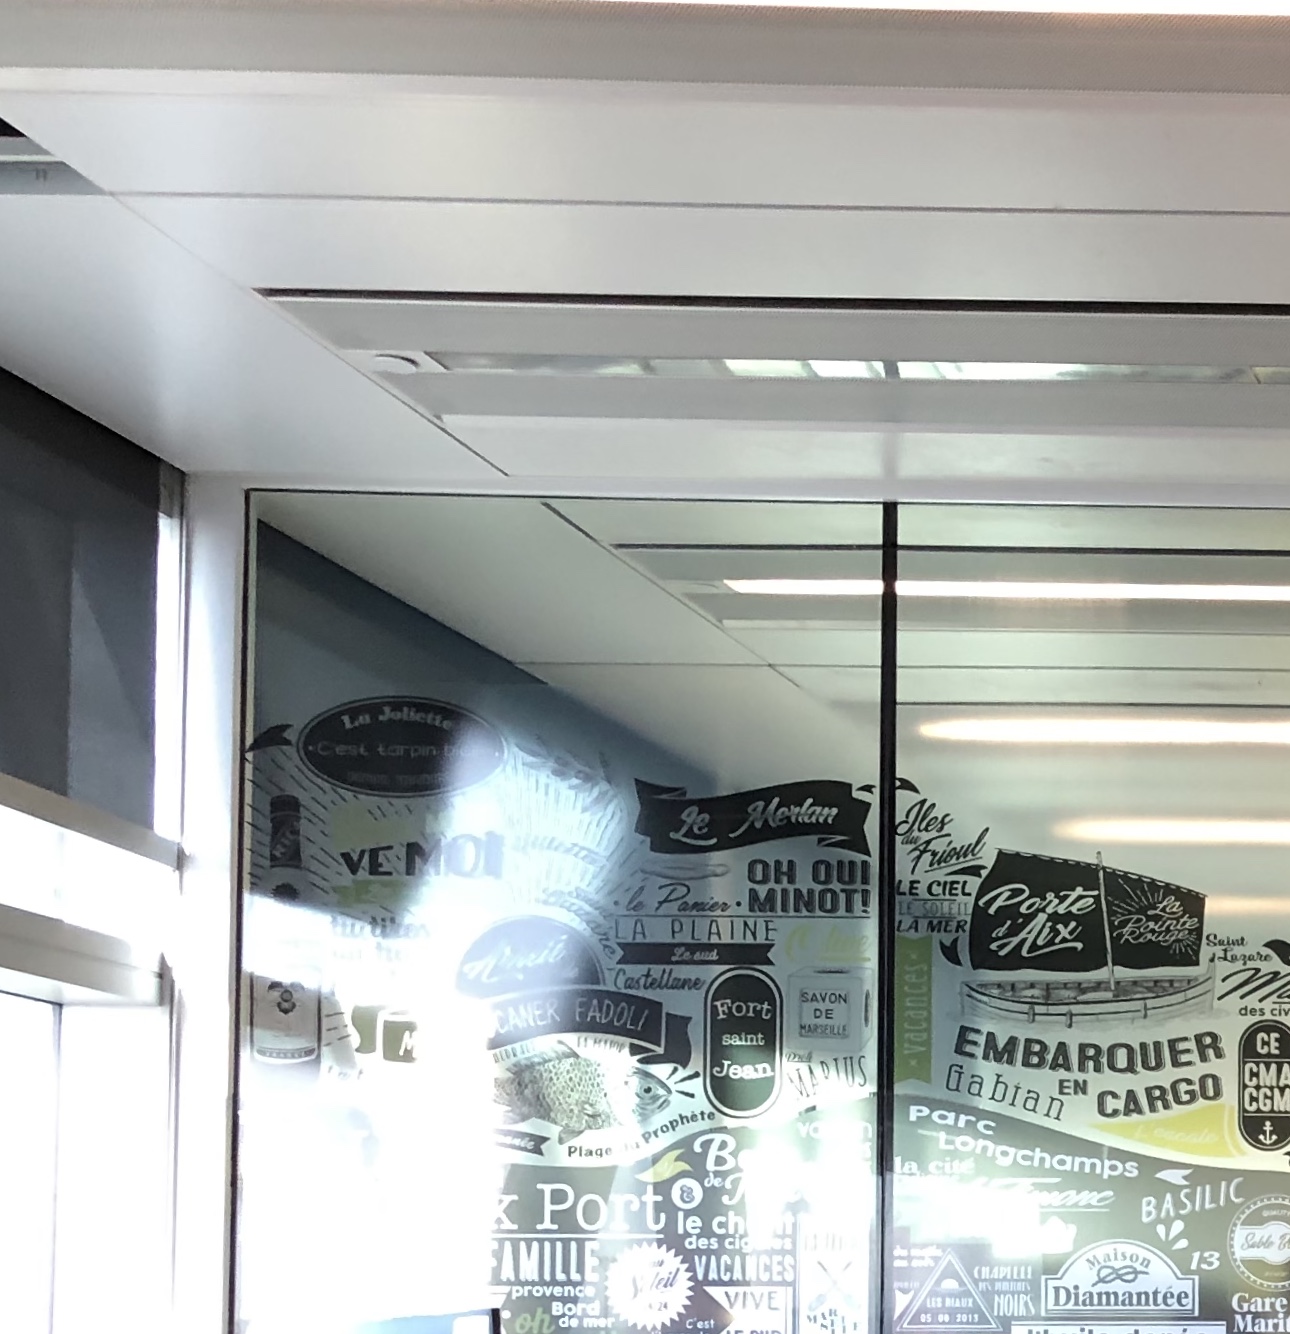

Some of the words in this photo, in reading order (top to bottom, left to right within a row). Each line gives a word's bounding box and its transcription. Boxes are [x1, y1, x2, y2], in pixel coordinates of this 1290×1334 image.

[670, 806, 718, 846] Le
[728, 797, 838, 838] Merlan
[748, 859, 796, 886] OH
[812, 859, 871, 886] OUI
[896, 880, 920, 896] LE
[927, 880, 972, 897] CIEL
[978, 883, 1100, 916] Porte
[748, 888, 872, 914] MINOT!
[614, 919, 647, 941] LA
[671, 919, 778, 942] PLAINE
[713, 999, 772, 1019] Fort
[801, 991, 848, 1005] SAVON
[813, 1008, 834, 1020] DE
[1239, 1005, 1268, 1017] des
[722, 1032, 765, 1046] saint
[953, 1025, 1227, 1074] EMBARQUER
[1256, 1032, 1280, 1055] CE
[712, 1060, 774, 1079] Jean
[945, 1063, 1066, 1121] Gabian
[1058, 1079, 1088, 1096] EN
[1097, 1073, 1224, 1118] CARGO
[909, 1105, 996, 1135] Parc
[938, 1131, 1140, 1179] Longchamps
[1141, 1178, 1245, 1224] BASILIC
[1085, 1251, 1152, 1270] Maison
[1190, 1251, 1221, 1270] 13
[1052, 1287, 1190, 1308] Diamantée
[1231, 1293, 1288, 1313] Gare
